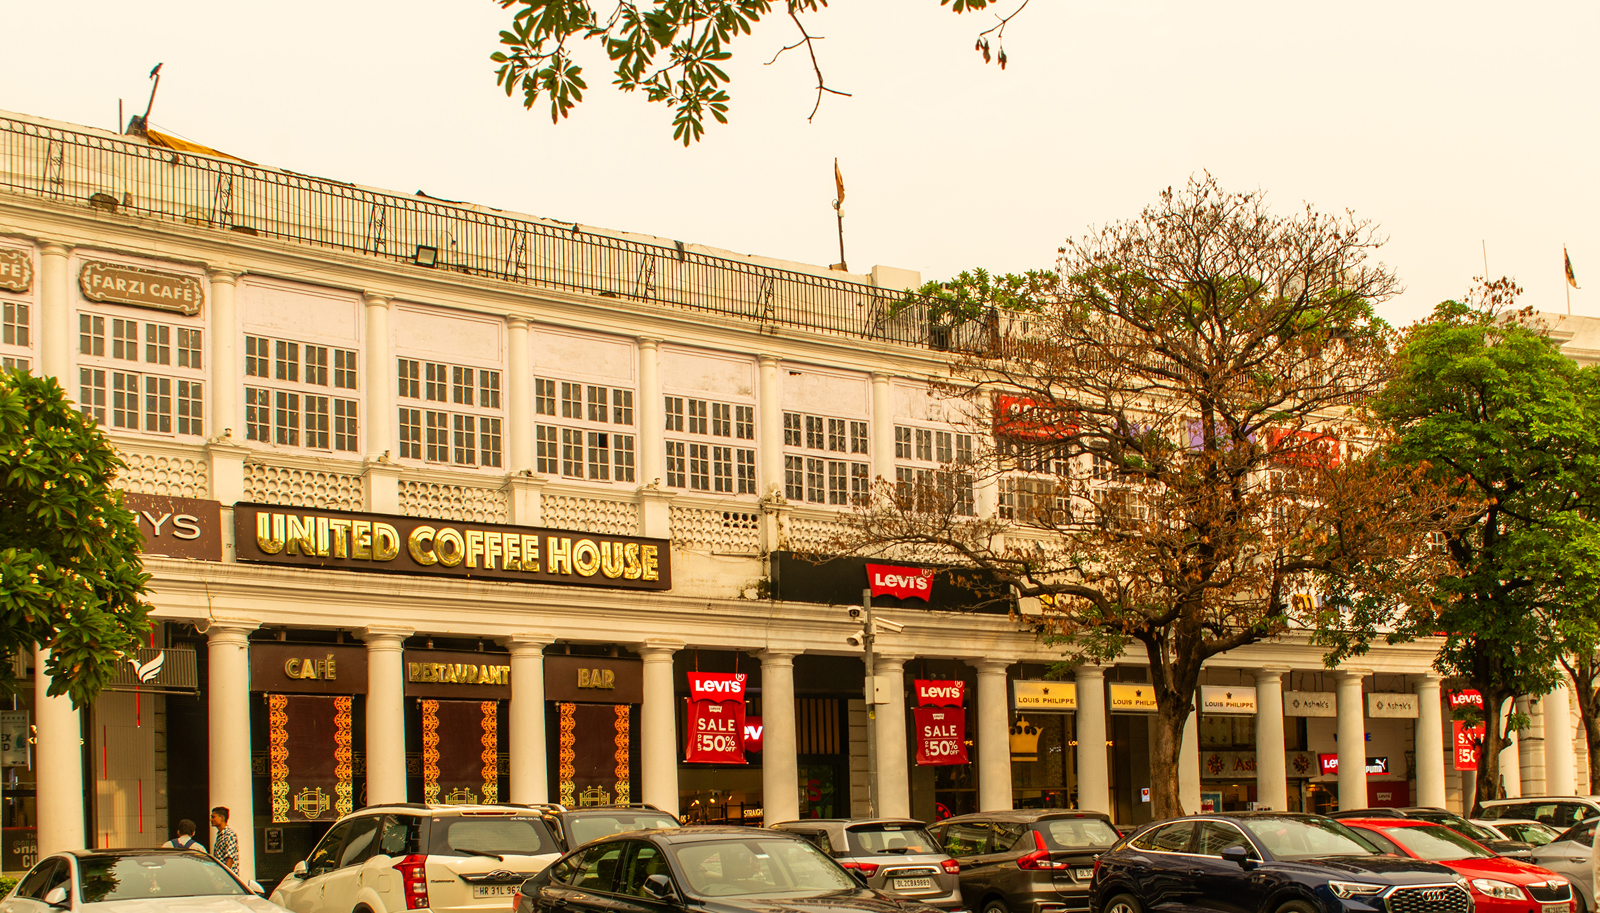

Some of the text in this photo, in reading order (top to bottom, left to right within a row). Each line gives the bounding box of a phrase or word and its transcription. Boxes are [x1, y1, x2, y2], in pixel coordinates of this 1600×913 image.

[92, 274, 193, 302] FARZI CAFÉ
[256, 511, 659, 581] UNITED COFFEE HOUSE
[284, 654, 337, 681] CAFÉ
[408, 662, 510, 685] RESTAURANT
[577, 668, 616, 690] BAR
[697, 717, 736, 732] SALE
[924, 725, 957, 737] SALE
